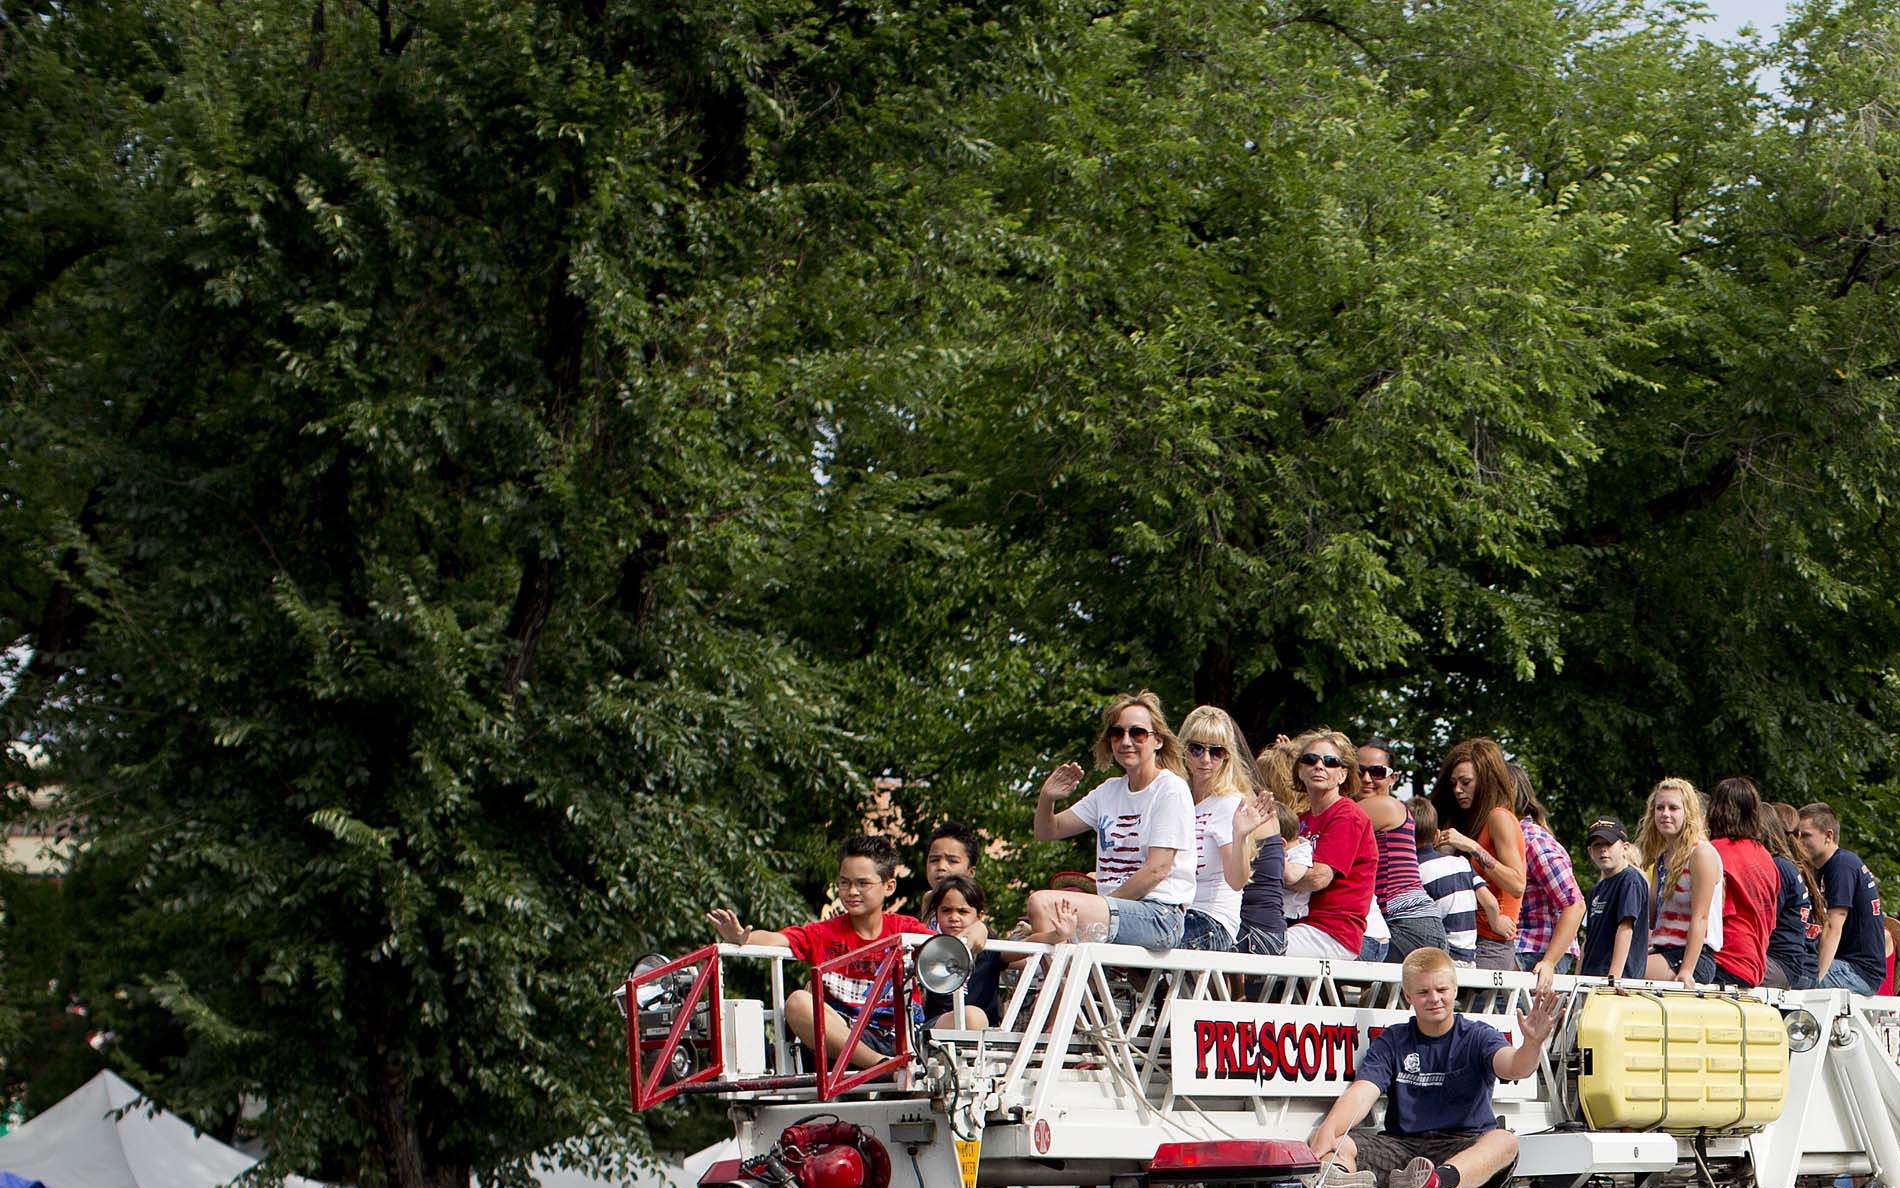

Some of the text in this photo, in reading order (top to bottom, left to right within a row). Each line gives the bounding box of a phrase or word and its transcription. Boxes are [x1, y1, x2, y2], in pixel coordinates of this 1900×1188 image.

[1319, 960, 1331, 977] 75
[1493, 971, 1504, 987] 65
[1194, 1019, 1360, 1089] PRESCOTT
